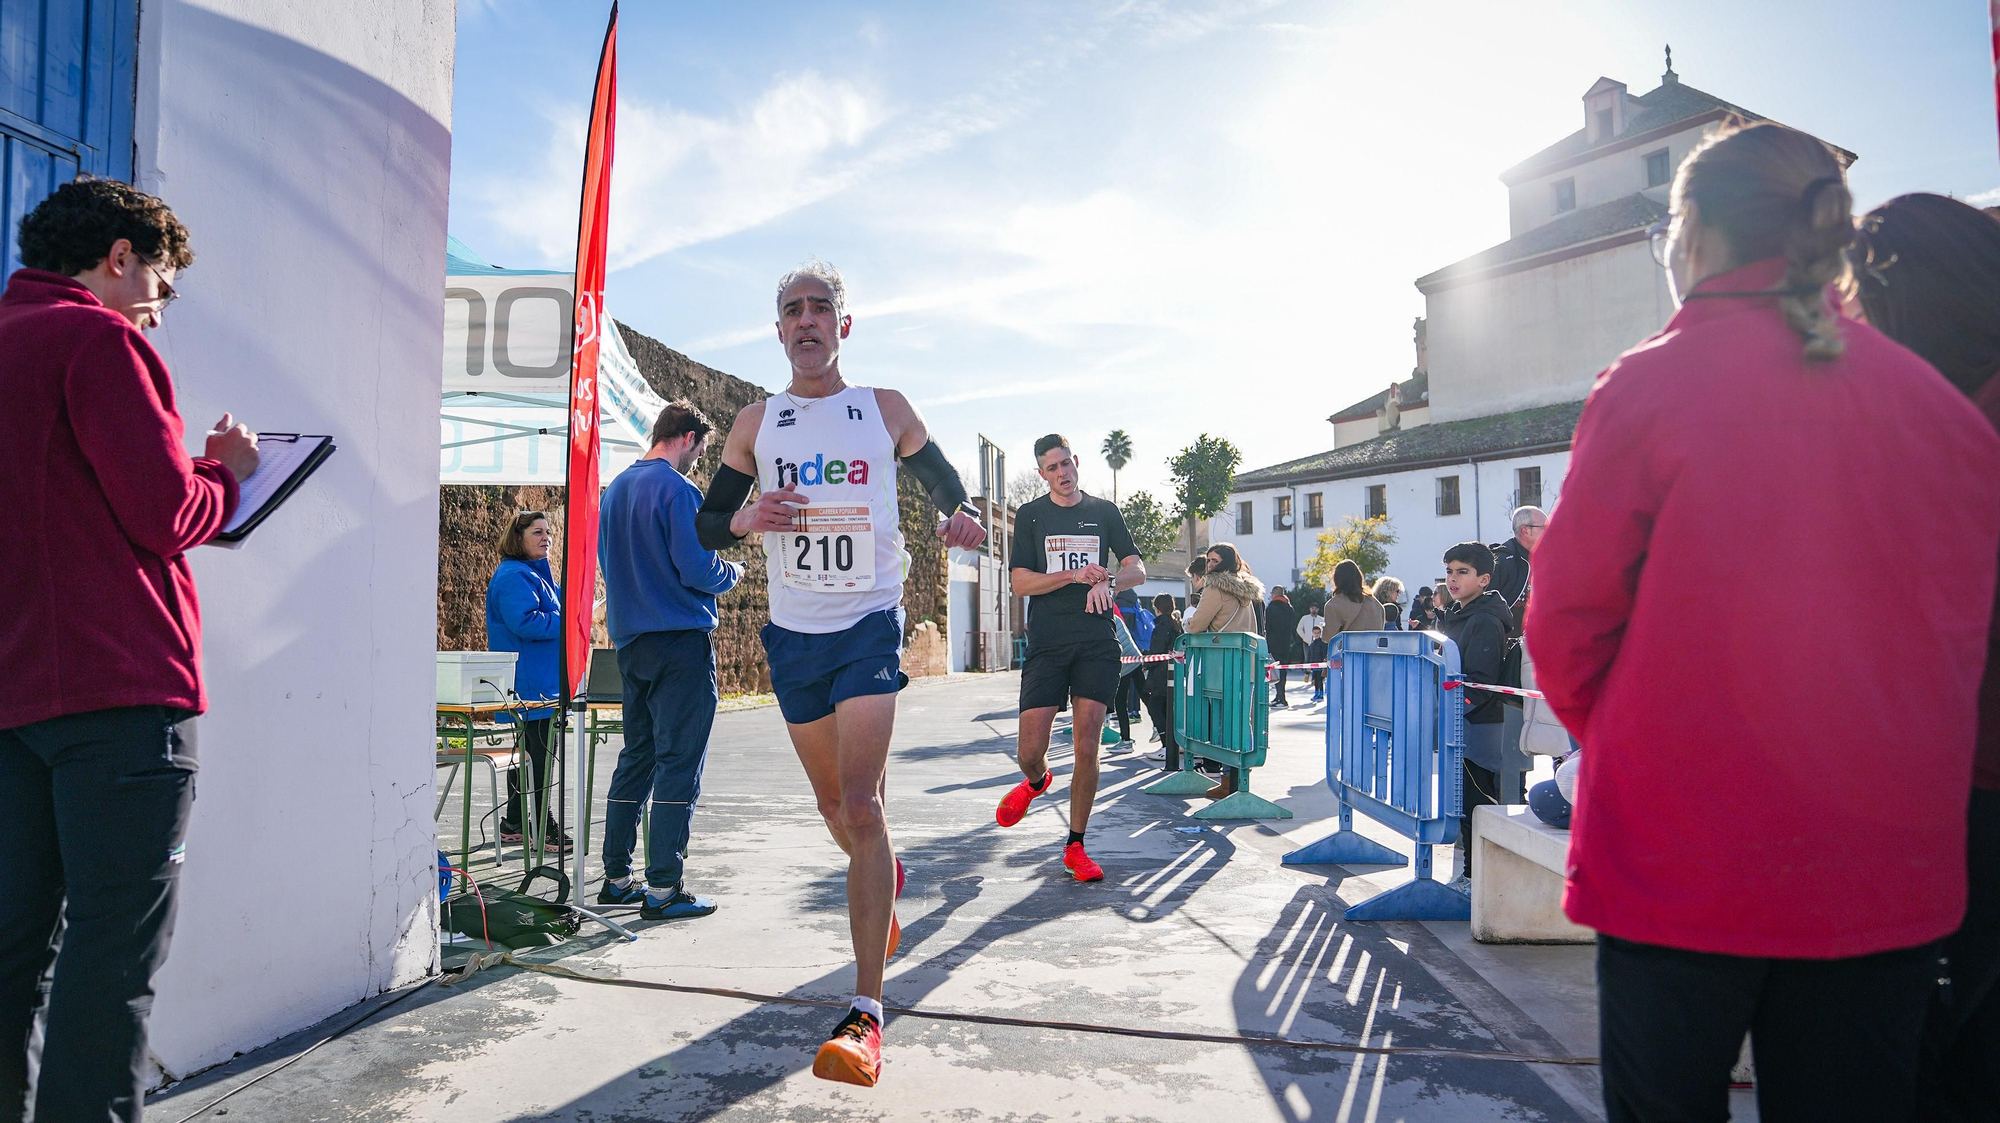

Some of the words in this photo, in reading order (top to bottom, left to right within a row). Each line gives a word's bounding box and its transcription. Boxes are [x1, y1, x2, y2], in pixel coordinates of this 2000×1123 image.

[847, 405, 863, 421] in
[775, 453, 869, 488] indea
[794, 535, 853, 571] 210
[1048, 538, 1066, 551] XLII
[1059, 552, 1089, 571] 165
